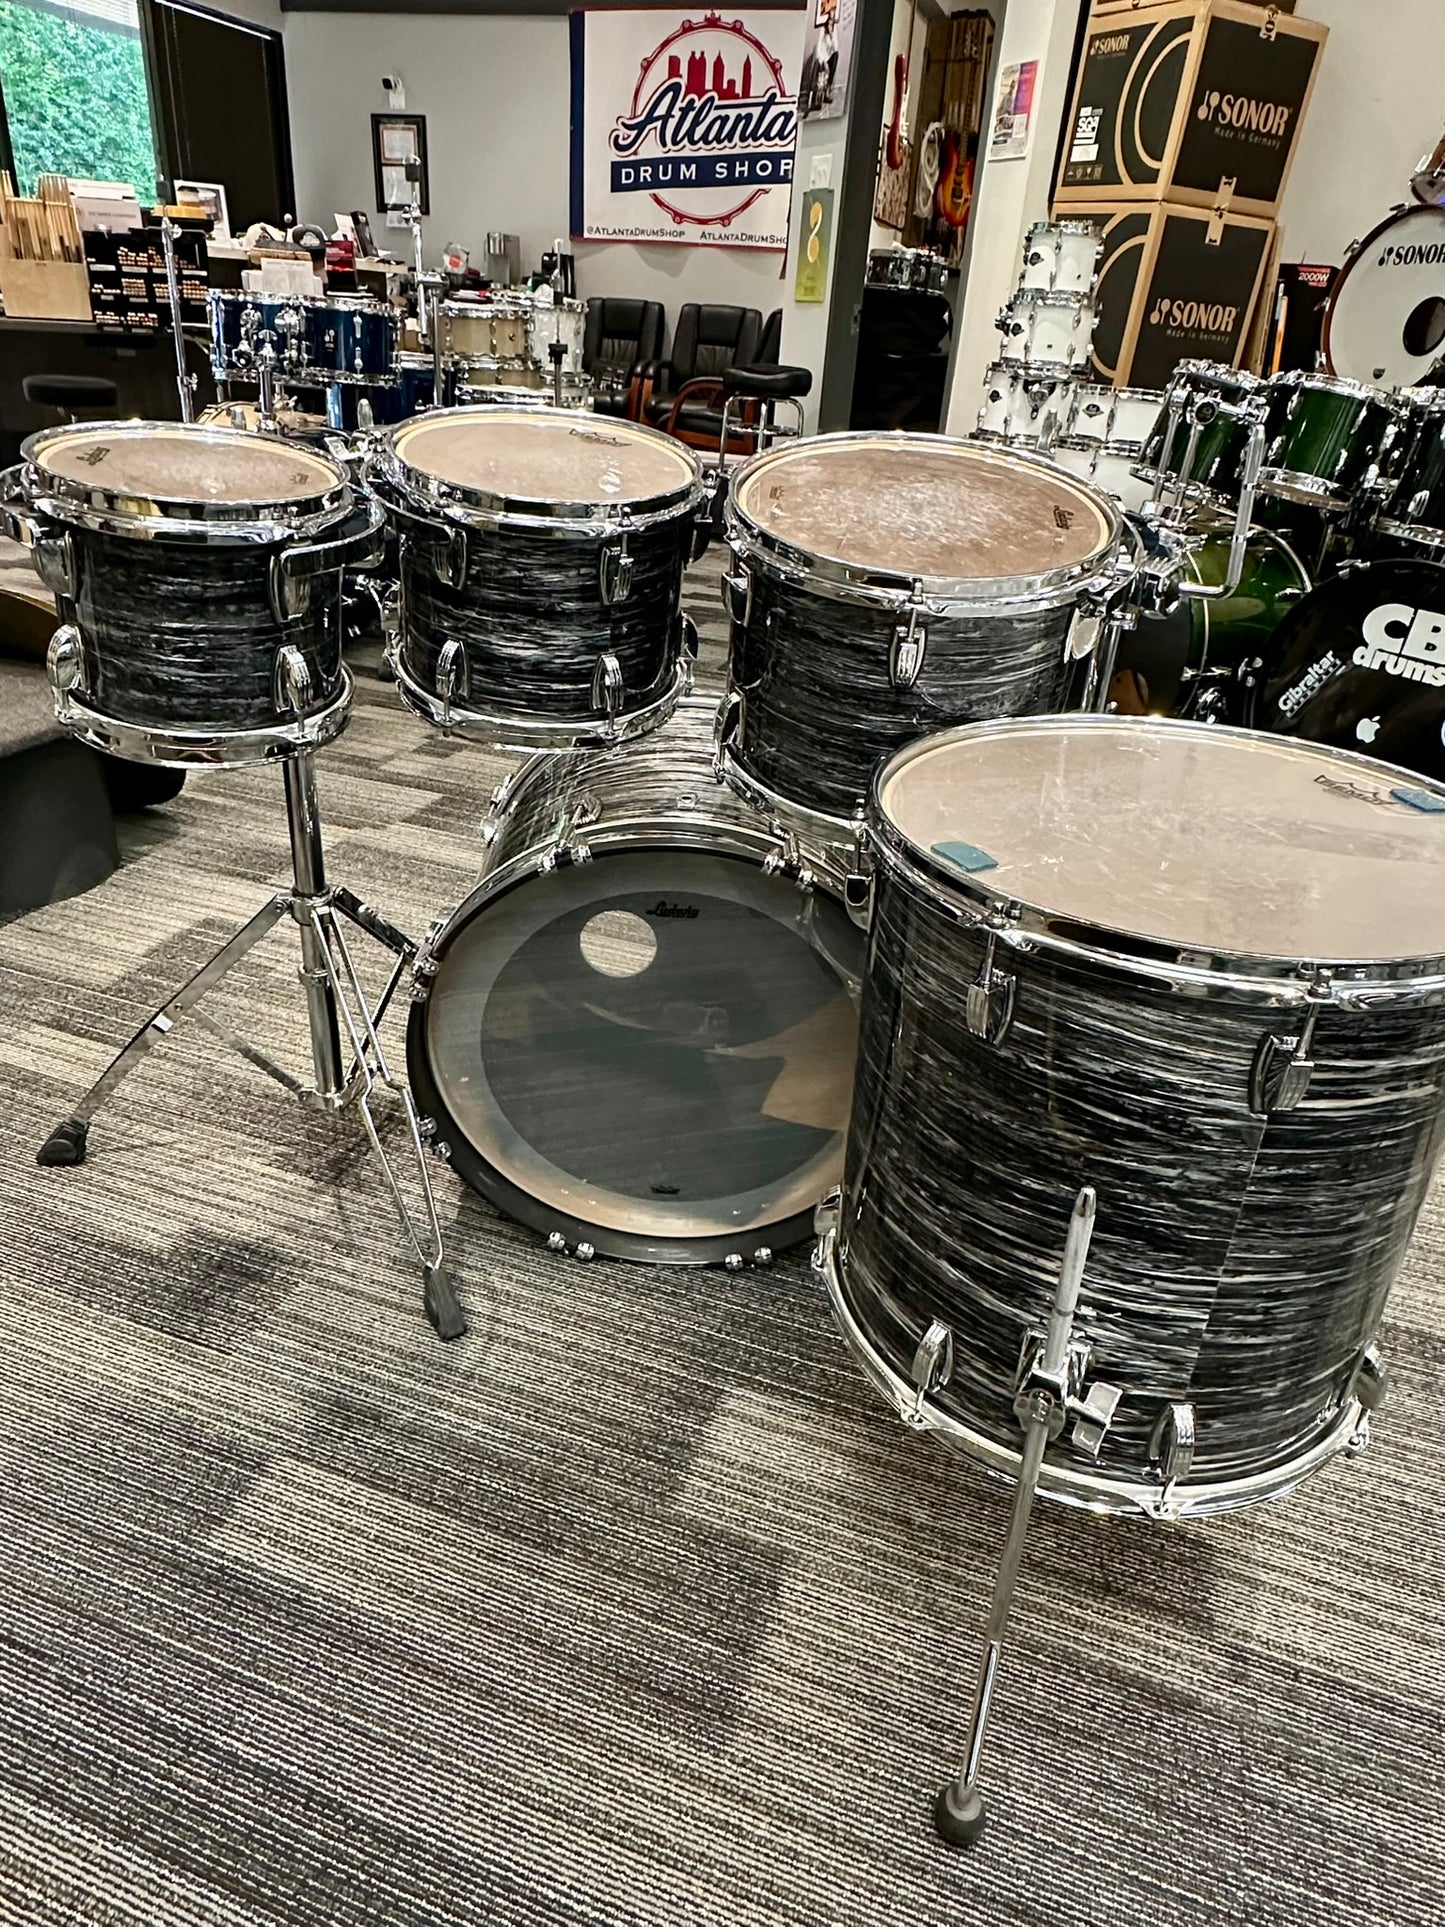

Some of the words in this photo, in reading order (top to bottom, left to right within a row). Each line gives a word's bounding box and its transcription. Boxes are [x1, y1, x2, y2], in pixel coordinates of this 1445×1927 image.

[1097, 34, 1130, 55] SONOR
[613, 81, 797, 150] Atlanta
[1218, 93, 1289, 136] SONOR
[621, 163, 697, 184] DRUM
[715, 159, 793, 179] SHOP
[1393, 243, 1445, 266] SONOR
[1169, 300, 1237, 333] SONOR
[1362, 603, 1445, 665] CB
[1278, 650, 1336, 711] Gibraltar
[1352, 645, 1445, 687] drums
[645, 900, 700, 919] Ludwig
